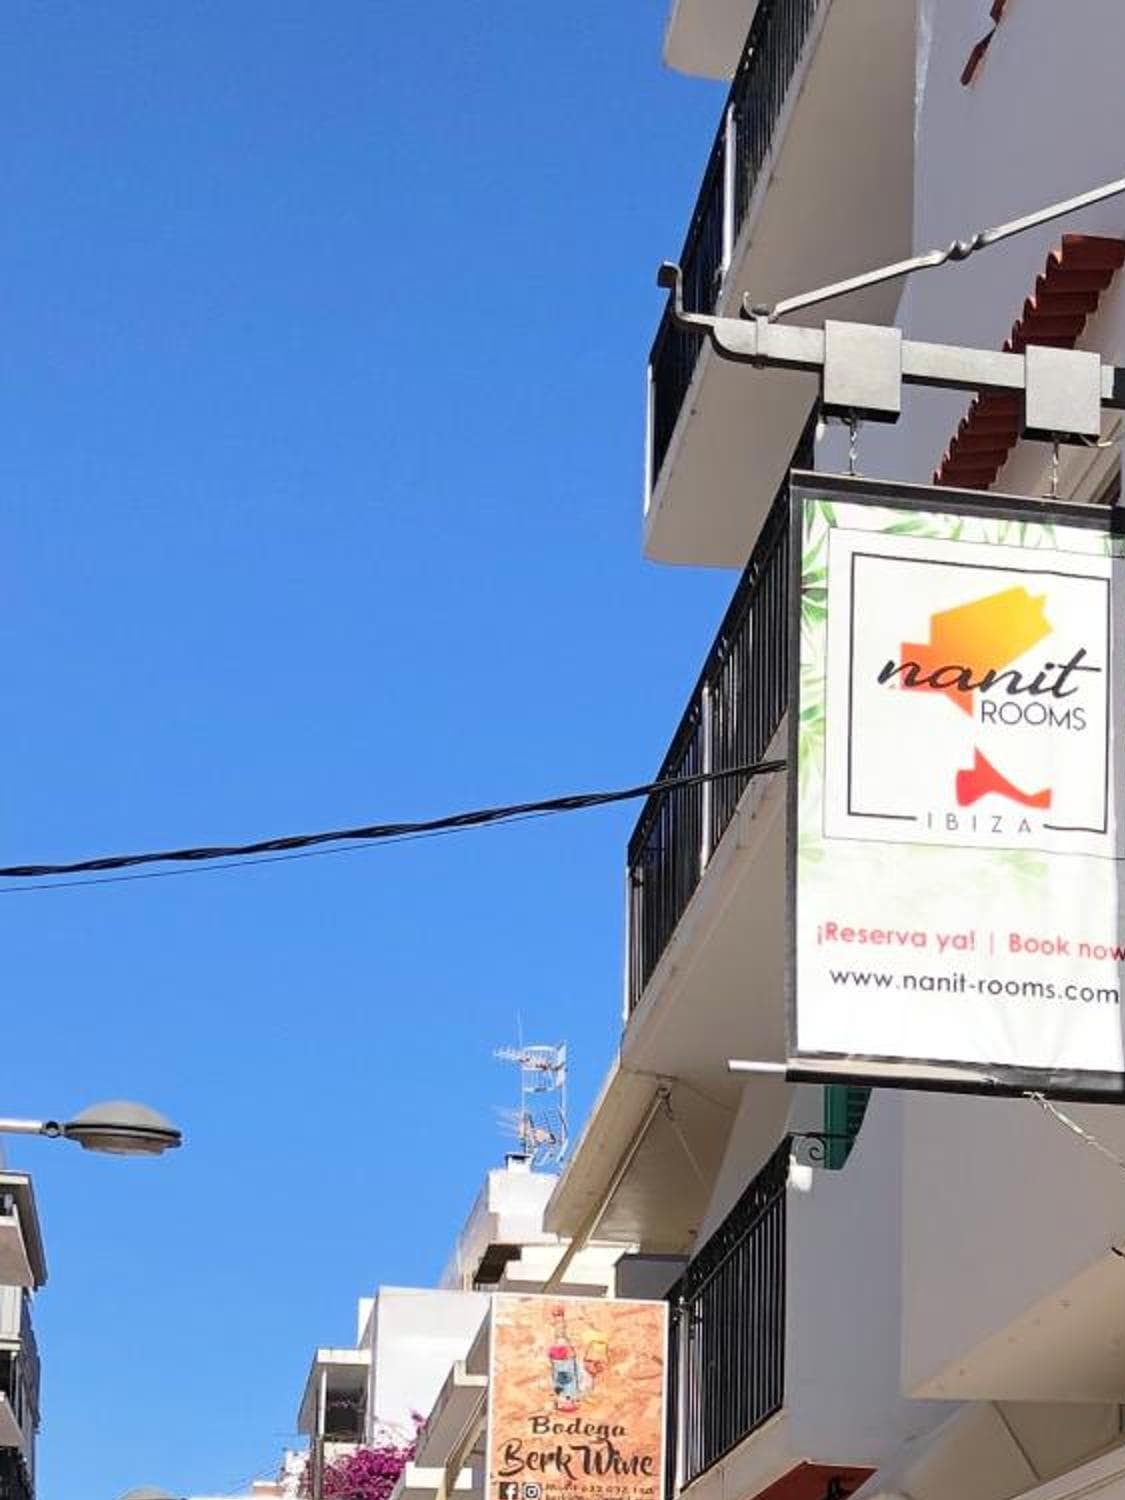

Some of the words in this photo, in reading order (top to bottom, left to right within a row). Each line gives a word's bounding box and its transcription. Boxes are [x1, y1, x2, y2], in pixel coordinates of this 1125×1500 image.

[877, 648, 1102, 698] nanit
[980, 700, 1086, 731] ROOMS
[926, 811, 1032, 834] IBIZA
[816, 922, 927, 948] ¡Reserva
[936, 930, 976, 954] ya!
[1008, 933, 1070, 956] Book
[829, 969, 1120, 1004] www.nanit-rooms.com
[528, 1415, 626, 1443] Bodega
[498, 1438, 578, 1480] Berk
[570, 1439, 653, 1476] Wine
